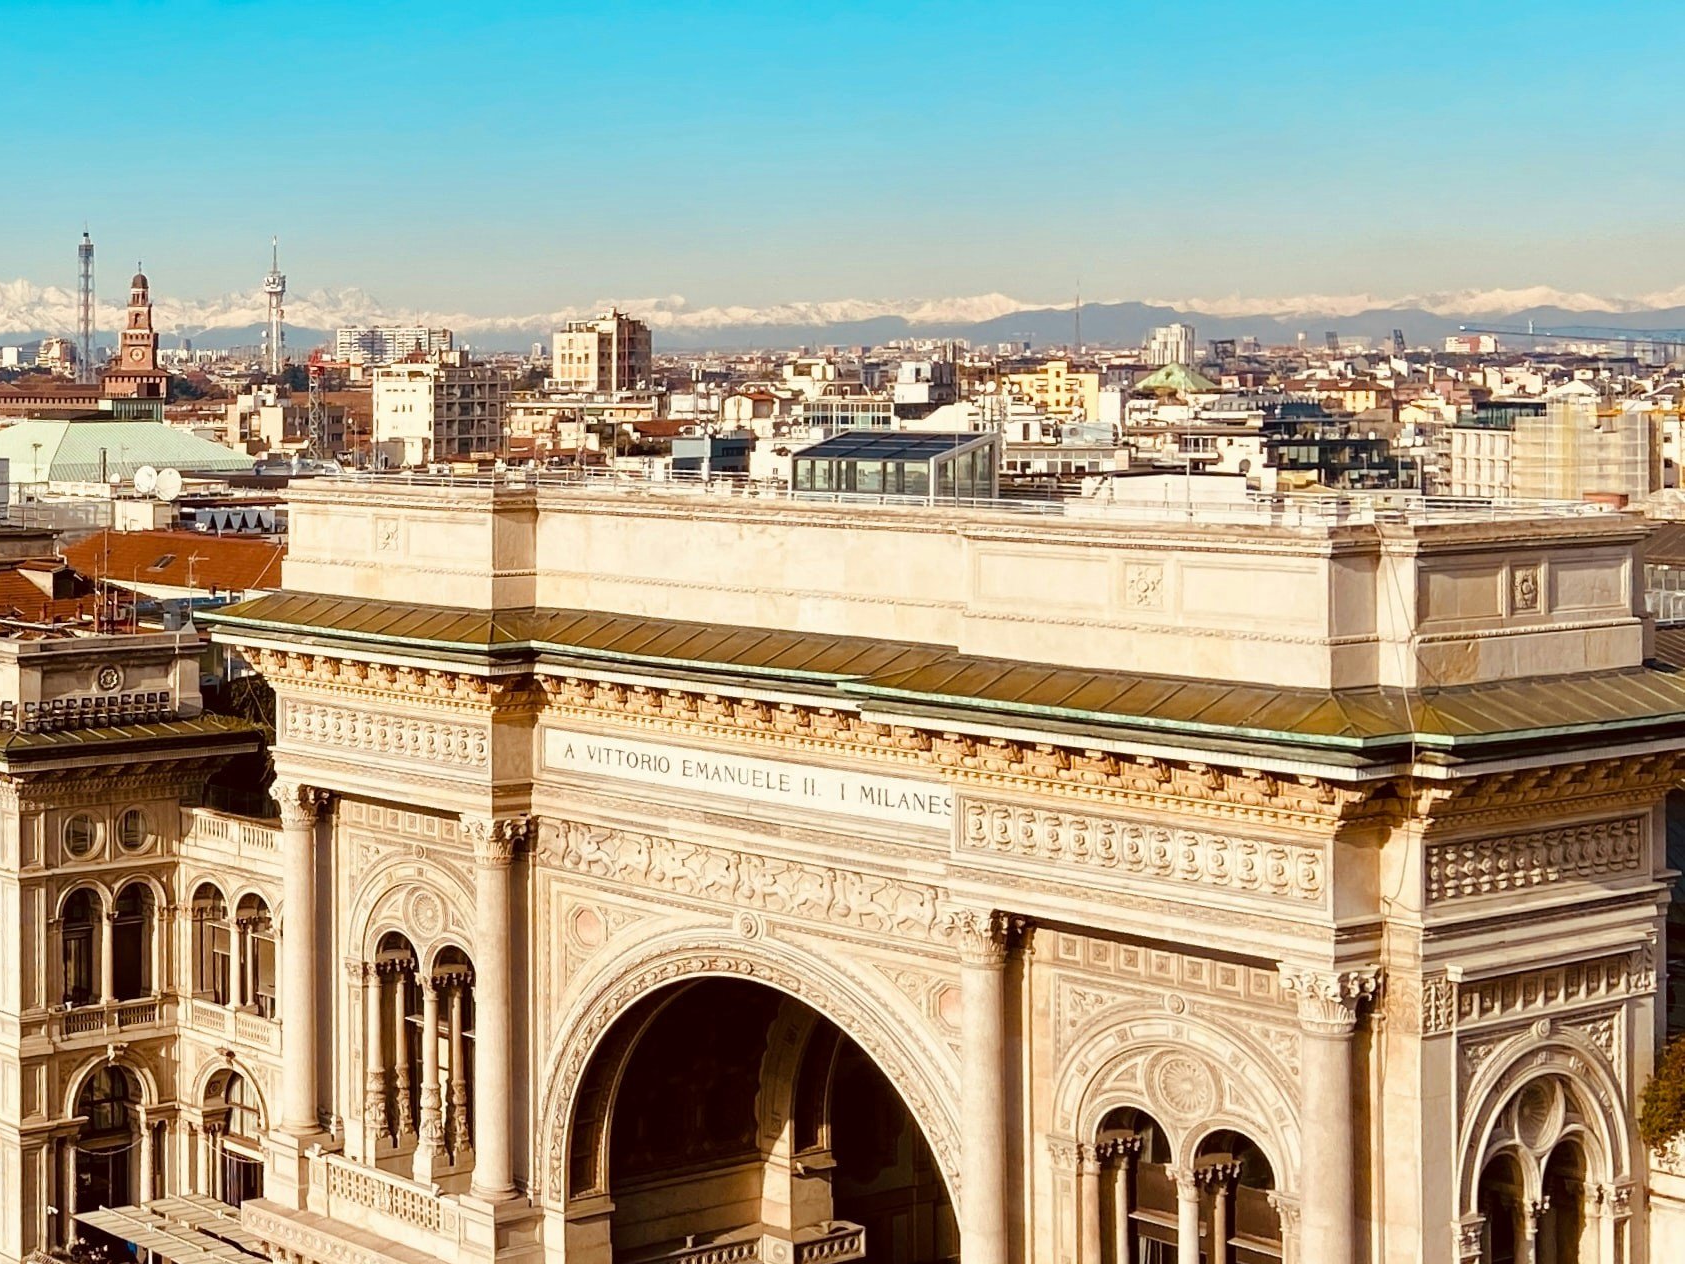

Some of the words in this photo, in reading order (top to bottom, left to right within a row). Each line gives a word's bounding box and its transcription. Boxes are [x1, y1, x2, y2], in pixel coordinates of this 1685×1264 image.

[565, 743, 575, 760] A
[587, 744, 671, 774] VITTORIO
[682, 759, 791, 793] EMANUELE
